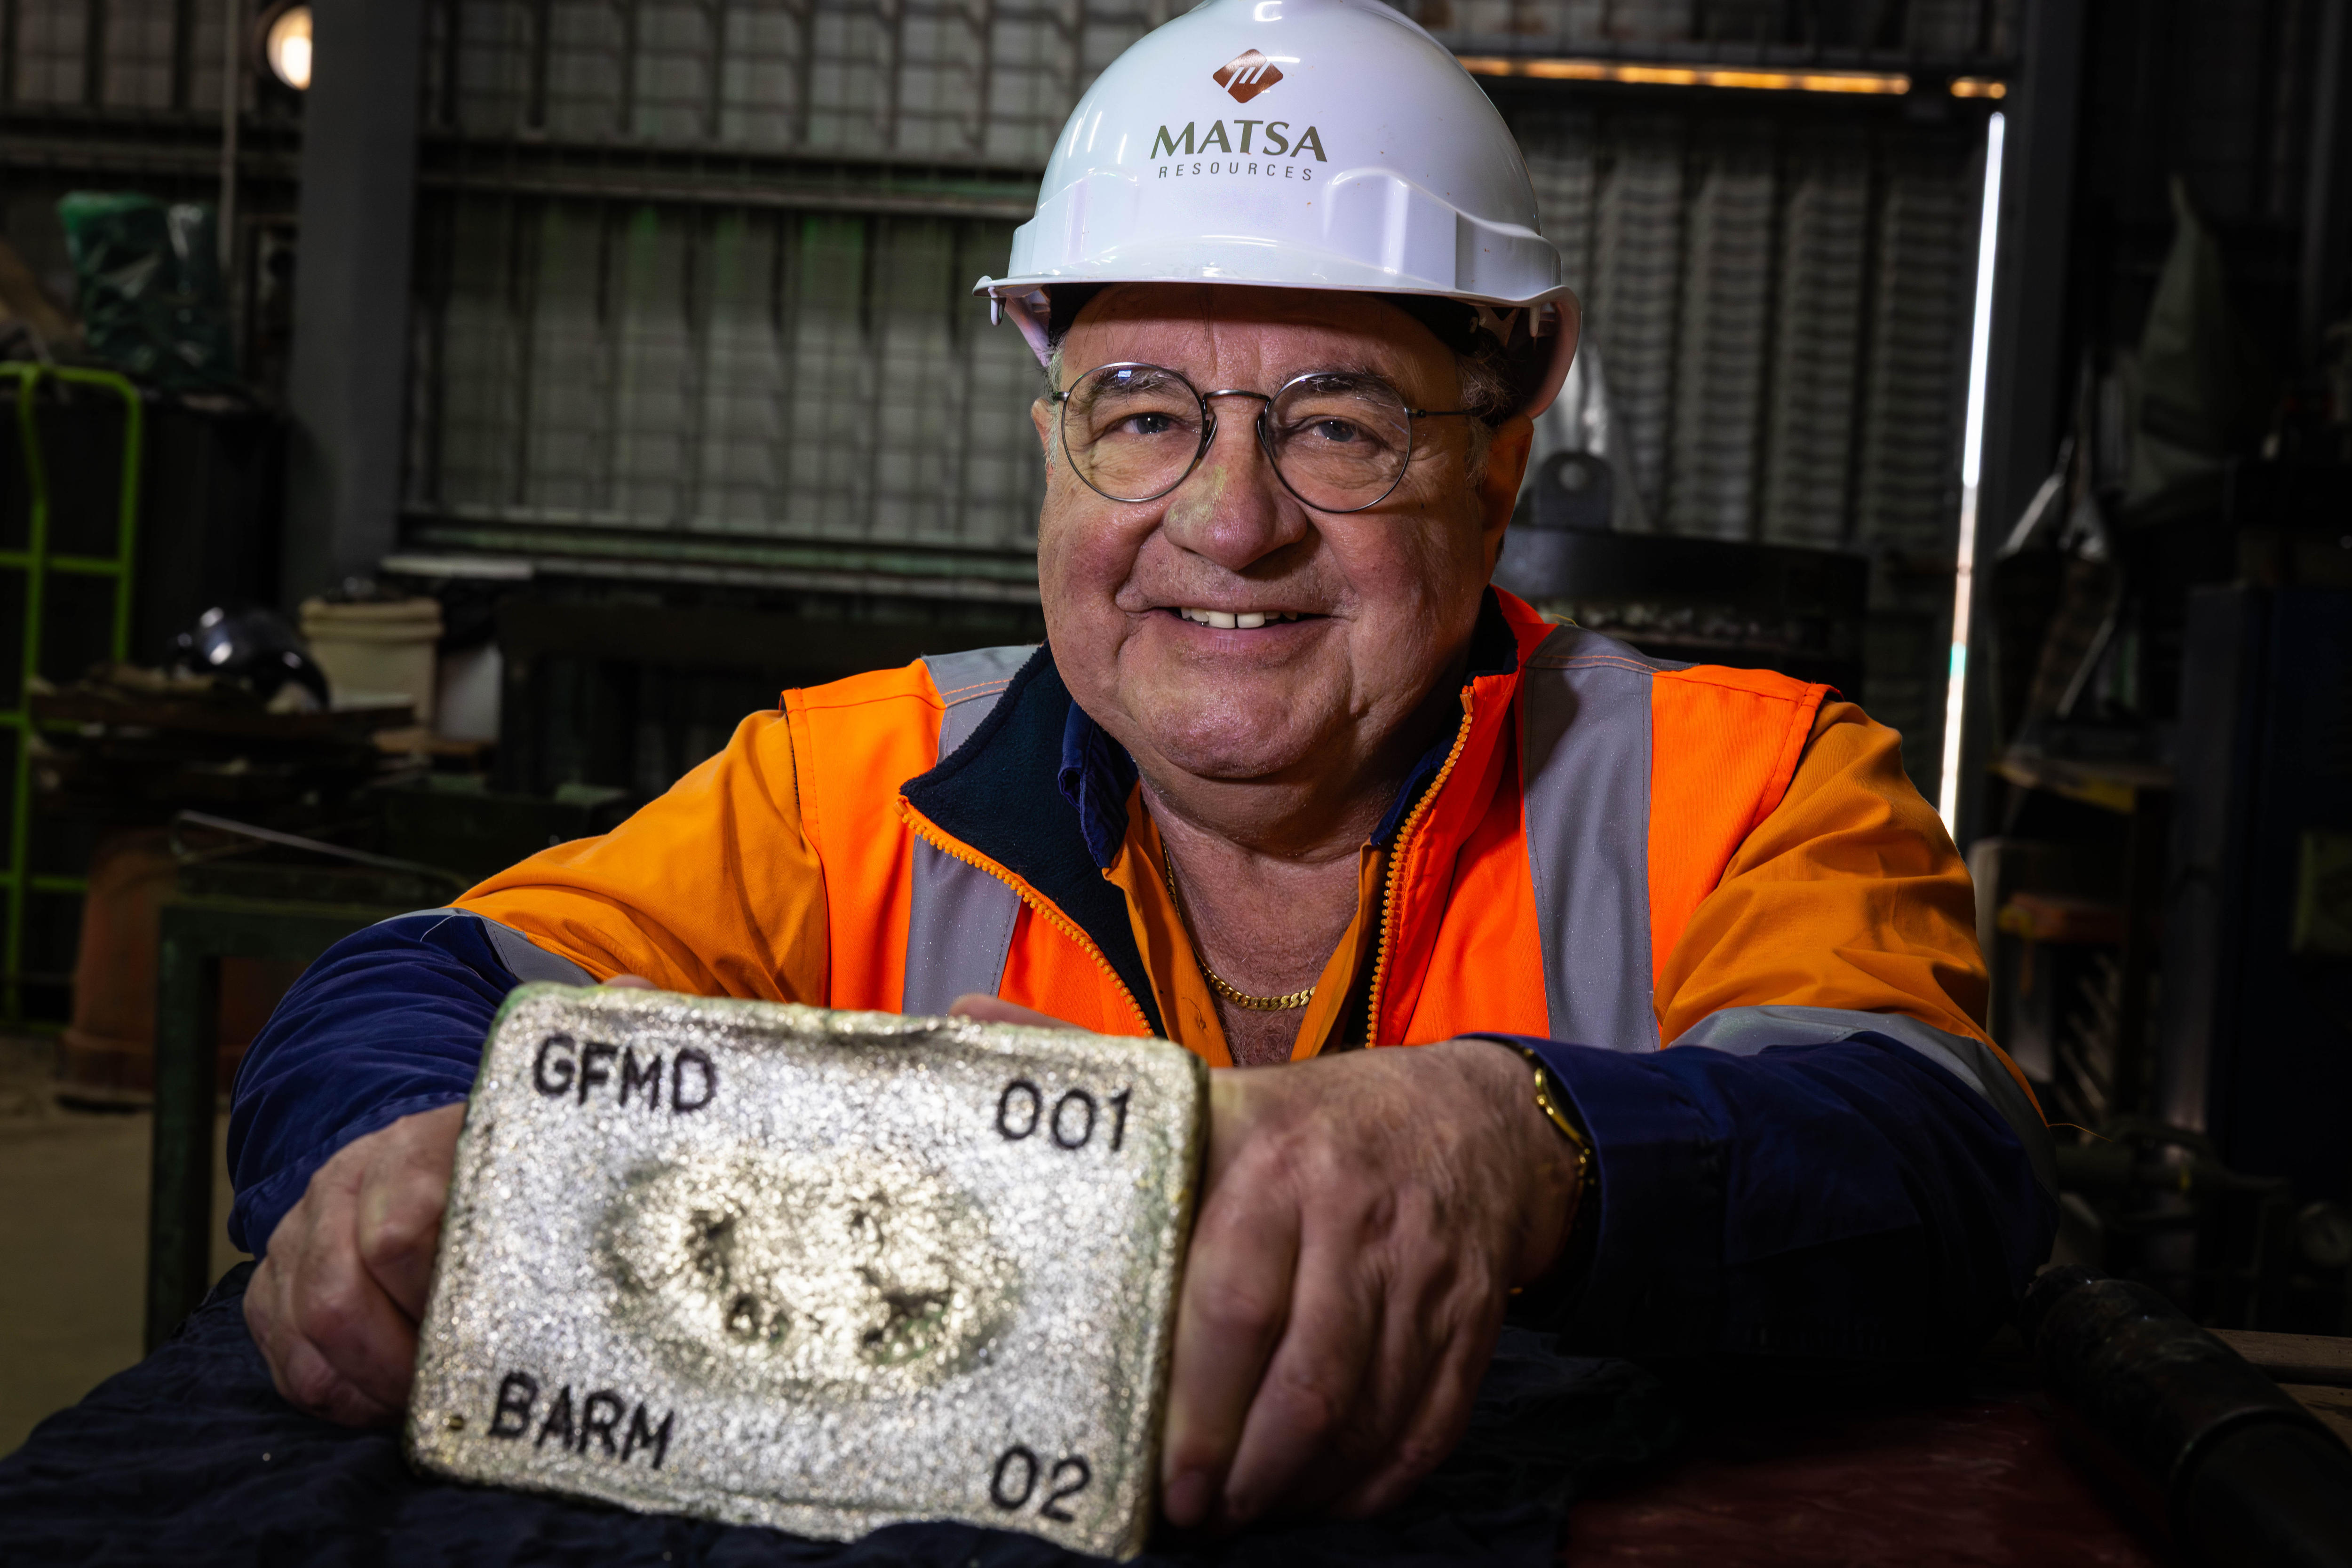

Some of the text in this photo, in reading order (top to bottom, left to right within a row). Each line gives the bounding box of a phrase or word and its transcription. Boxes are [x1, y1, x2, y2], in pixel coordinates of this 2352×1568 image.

[1150, 119, 1327, 162] MATSA
[1159, 162, 1312, 181] RESOURCES
[533, 1033, 1132, 1151] GFMD 001
[487, 1370, 1092, 1523] BARM 02
